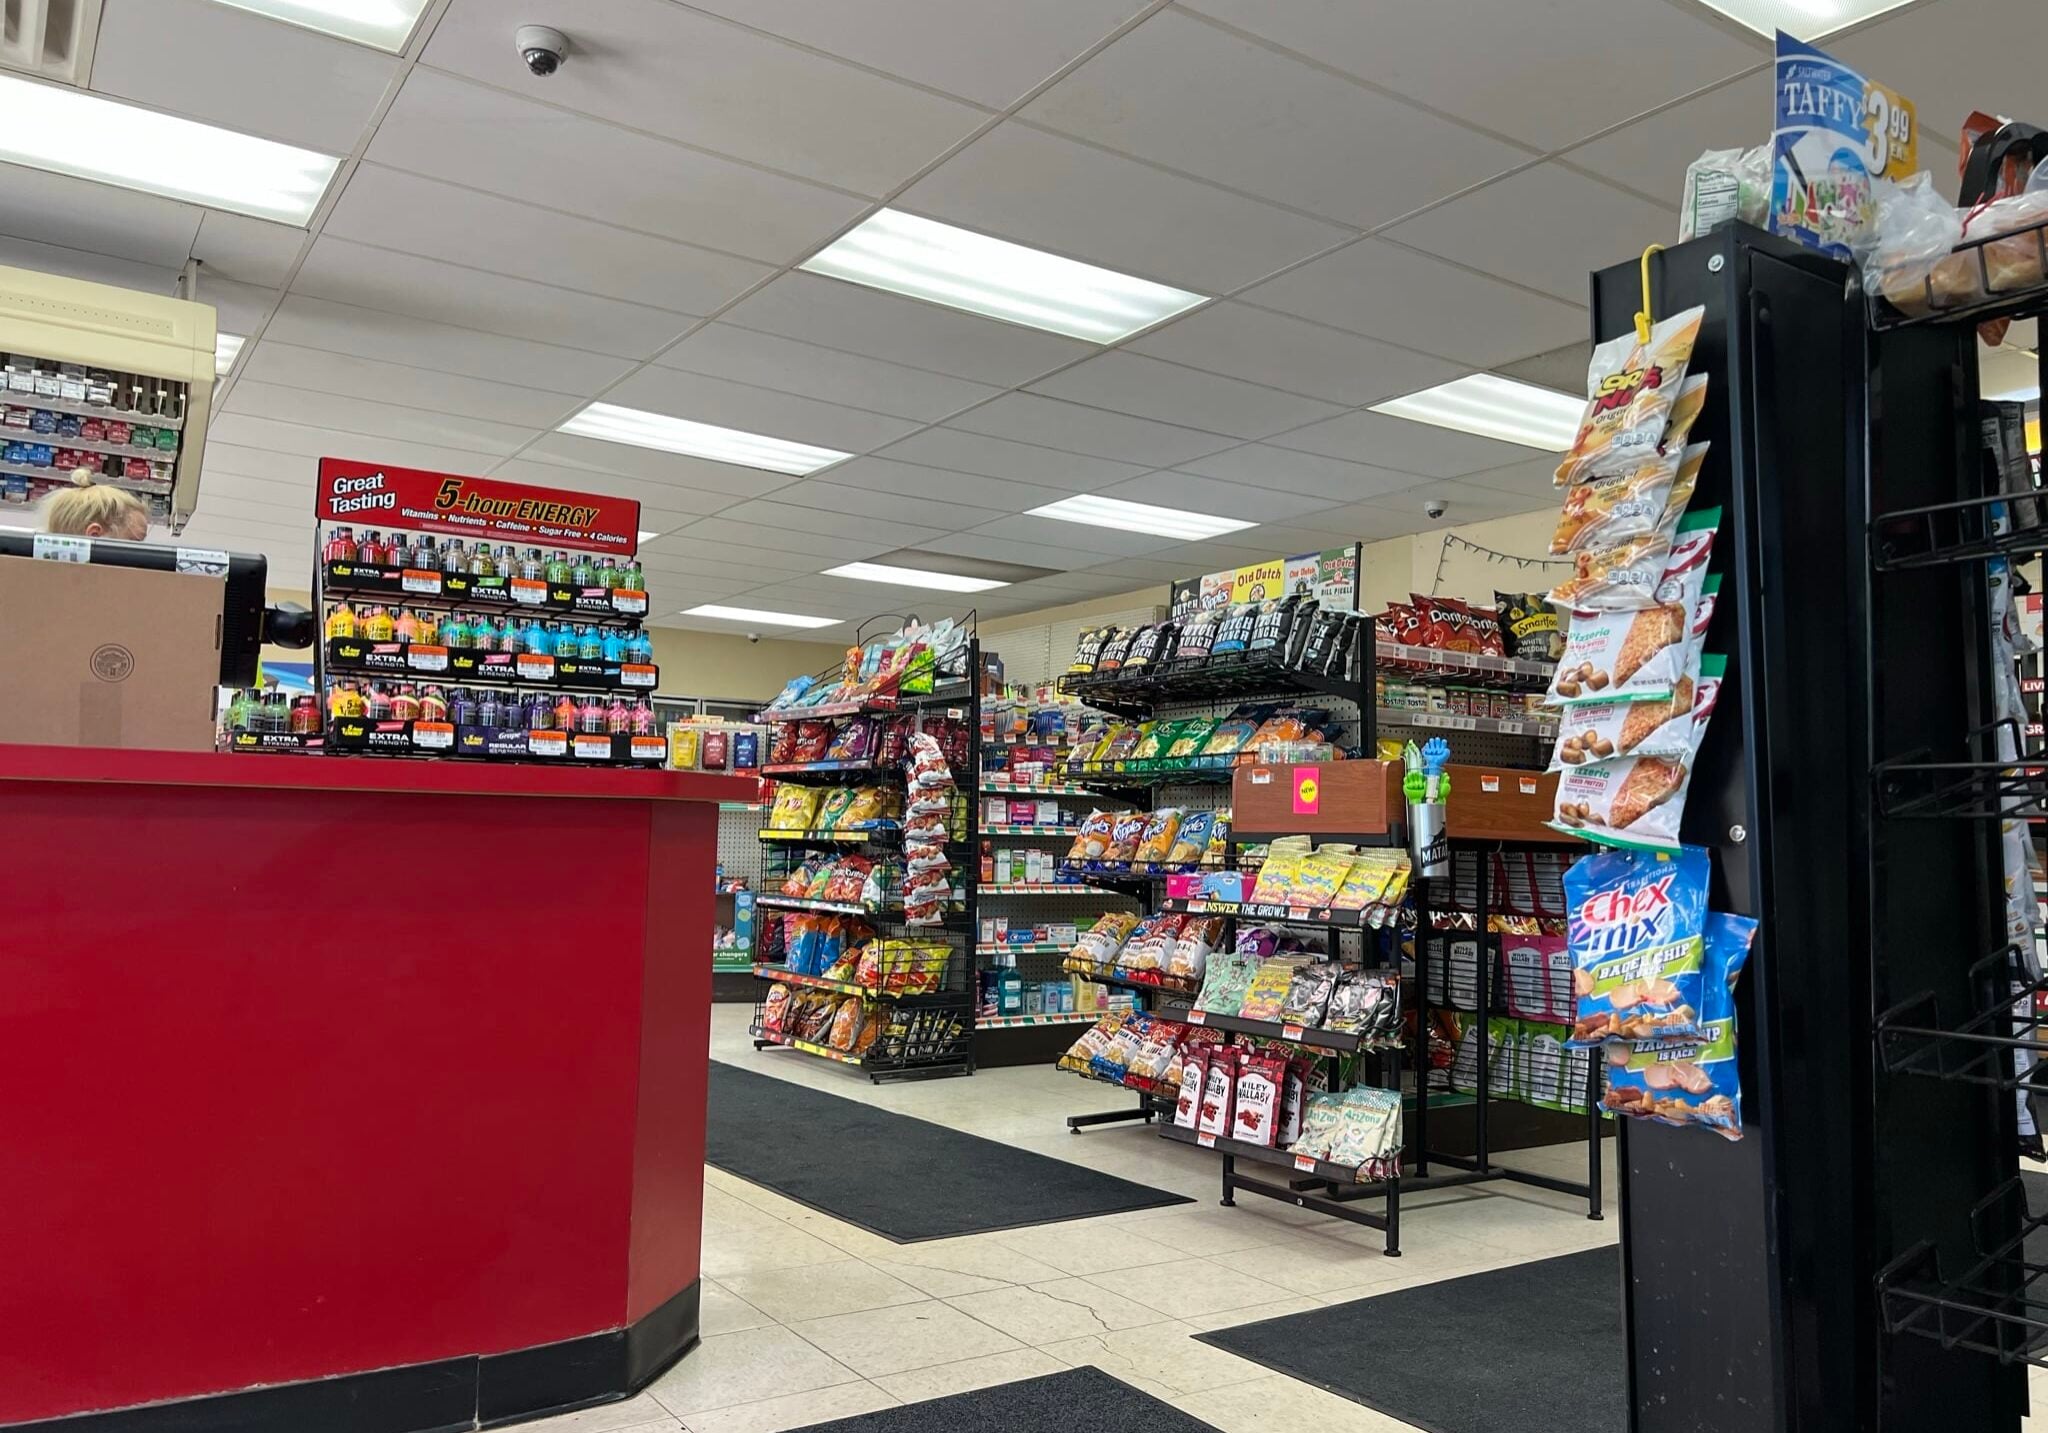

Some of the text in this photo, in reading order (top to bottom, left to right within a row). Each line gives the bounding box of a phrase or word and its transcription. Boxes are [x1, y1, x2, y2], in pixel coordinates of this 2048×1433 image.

[1784, 81, 1862, 131] TAFFY
[1891, 105, 1909, 143] 99
[333, 473, 384, 495] Great
[329, 492, 396, 513] Tasting
[435, 478, 600, 528] 5-hour ENERGY
[401, 508, 628, 544] Vitamins Nutrients Caffeine Sugar Free 4 Calories
[1323, 560, 1337, 572] Old
[1238, 567, 1281, 587] Old Dutch
[471, 587, 507, 596] EXTRA
[1202, 589, 1229, 611] Ripples
[575, 598, 609, 606] EXTRA
[1172, 598, 1198, 617] DUTCH
[1431, 609, 1467, 623] Dorito
[1518, 616, 1557, 636] Smartfoo
[365, 654, 405, 663] EXTRA
[478, 664, 515, 673] EXTRA
[369, 733, 409, 741] EXTRA
[499, 731, 521, 740] Grape
[1301, 786, 1316, 794] NEW!
[1583, 874, 1675, 923] Chex
[1241, 903, 1257, 916] THE
[1257, 904, 1287, 918] GROWL
[1598, 942, 1691, 980] BAGEL CHIP
[1658, 1052, 1669, 1062] IS
[1241, 1081, 1267, 1091] WILEY
[1238, 1088, 1270, 1105] WALLABY
